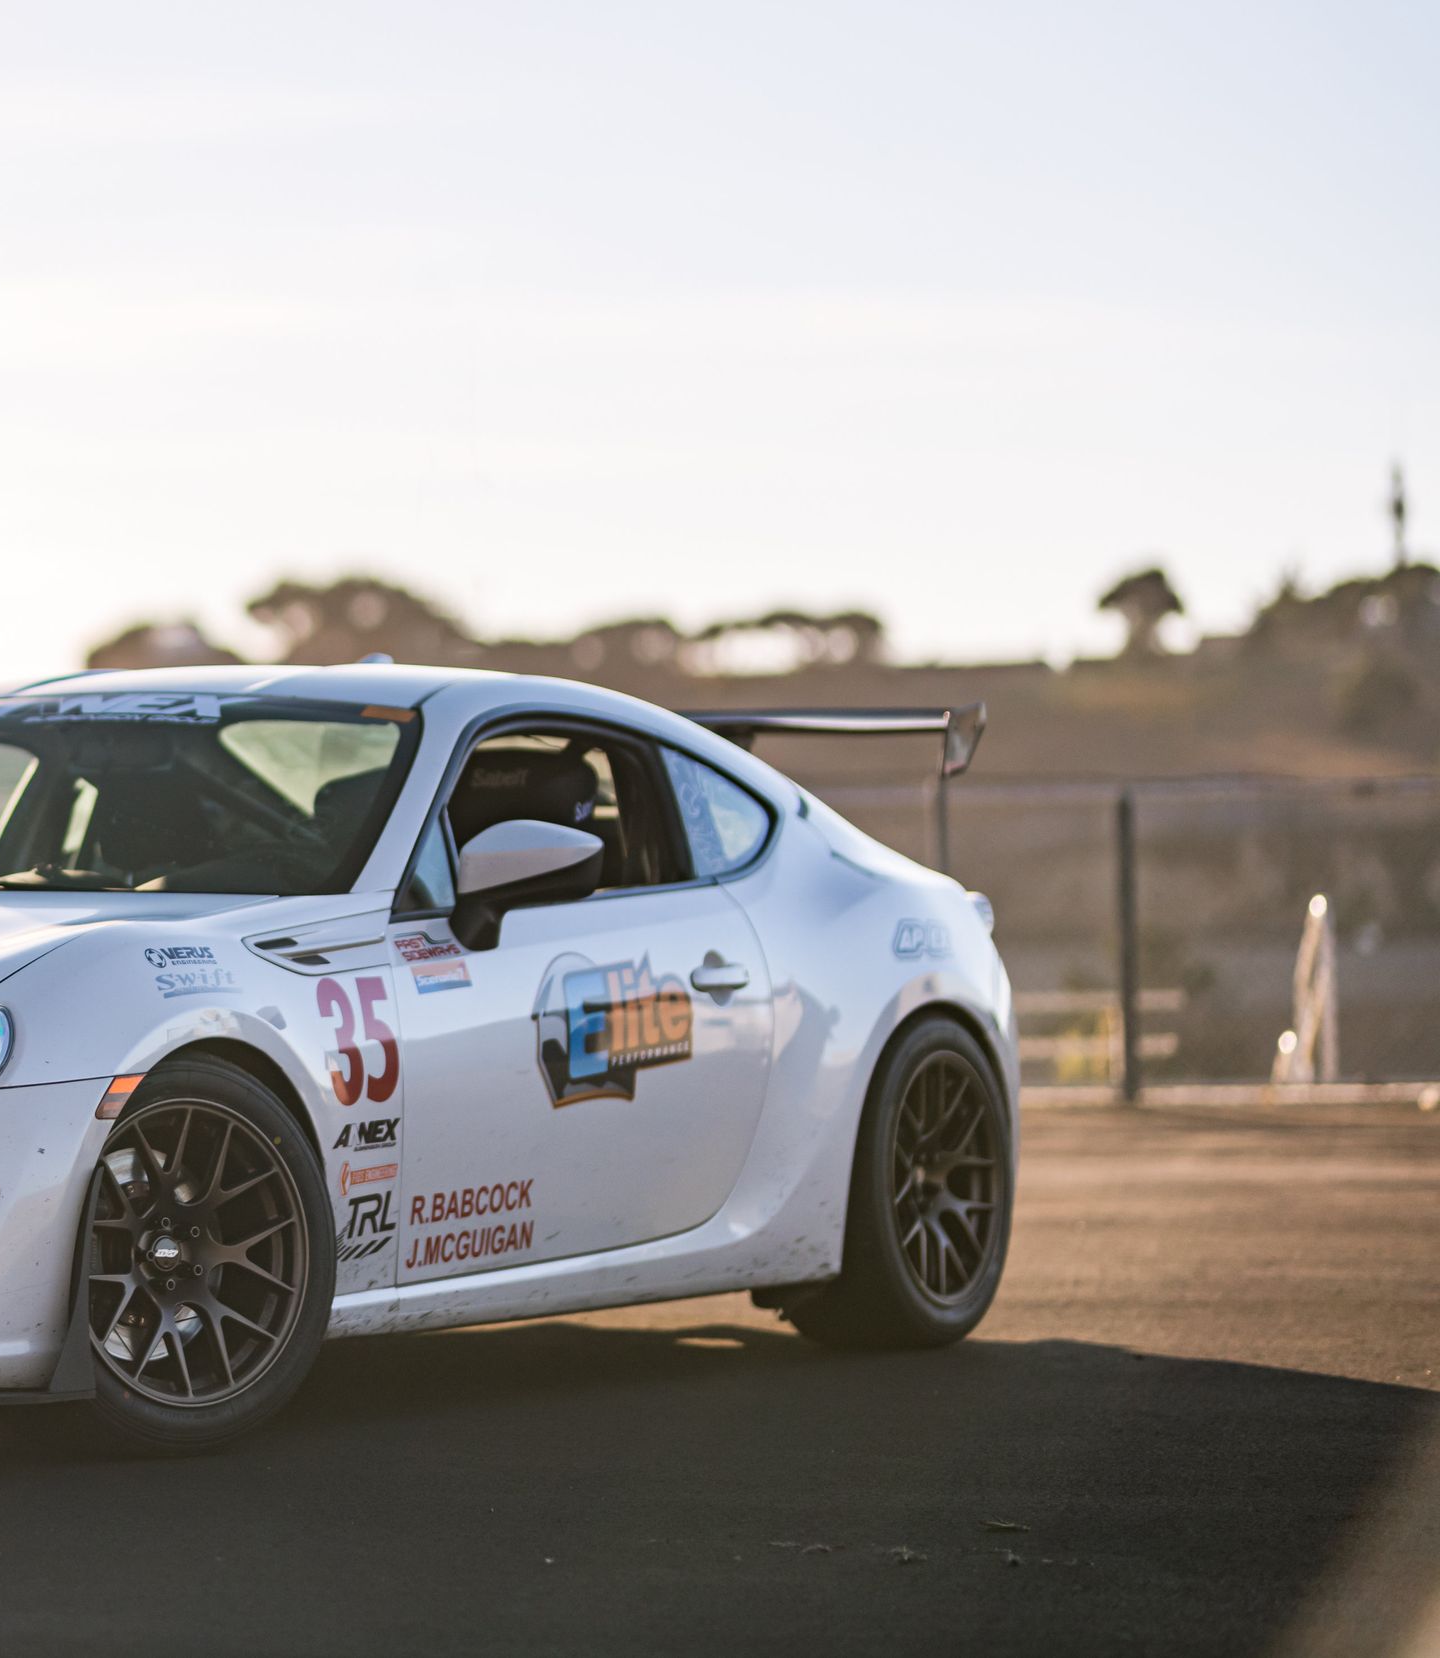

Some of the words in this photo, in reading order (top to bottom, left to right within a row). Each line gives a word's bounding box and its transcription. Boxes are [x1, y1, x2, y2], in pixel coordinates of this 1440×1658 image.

[161, 946, 215, 960] VERUS
[401, 943, 462, 962] SIDEWAYS
[563, 951, 691, 1079] Elite
[316, 976, 400, 1106] 35
[611, 1040, 689, 1067] PERFORMANCE
[348, 1190, 397, 1239] TRL
[409, 1178, 535, 1226] R.BABCOCK
[405, 1220, 535, 1269] J.MCGUIGAN
